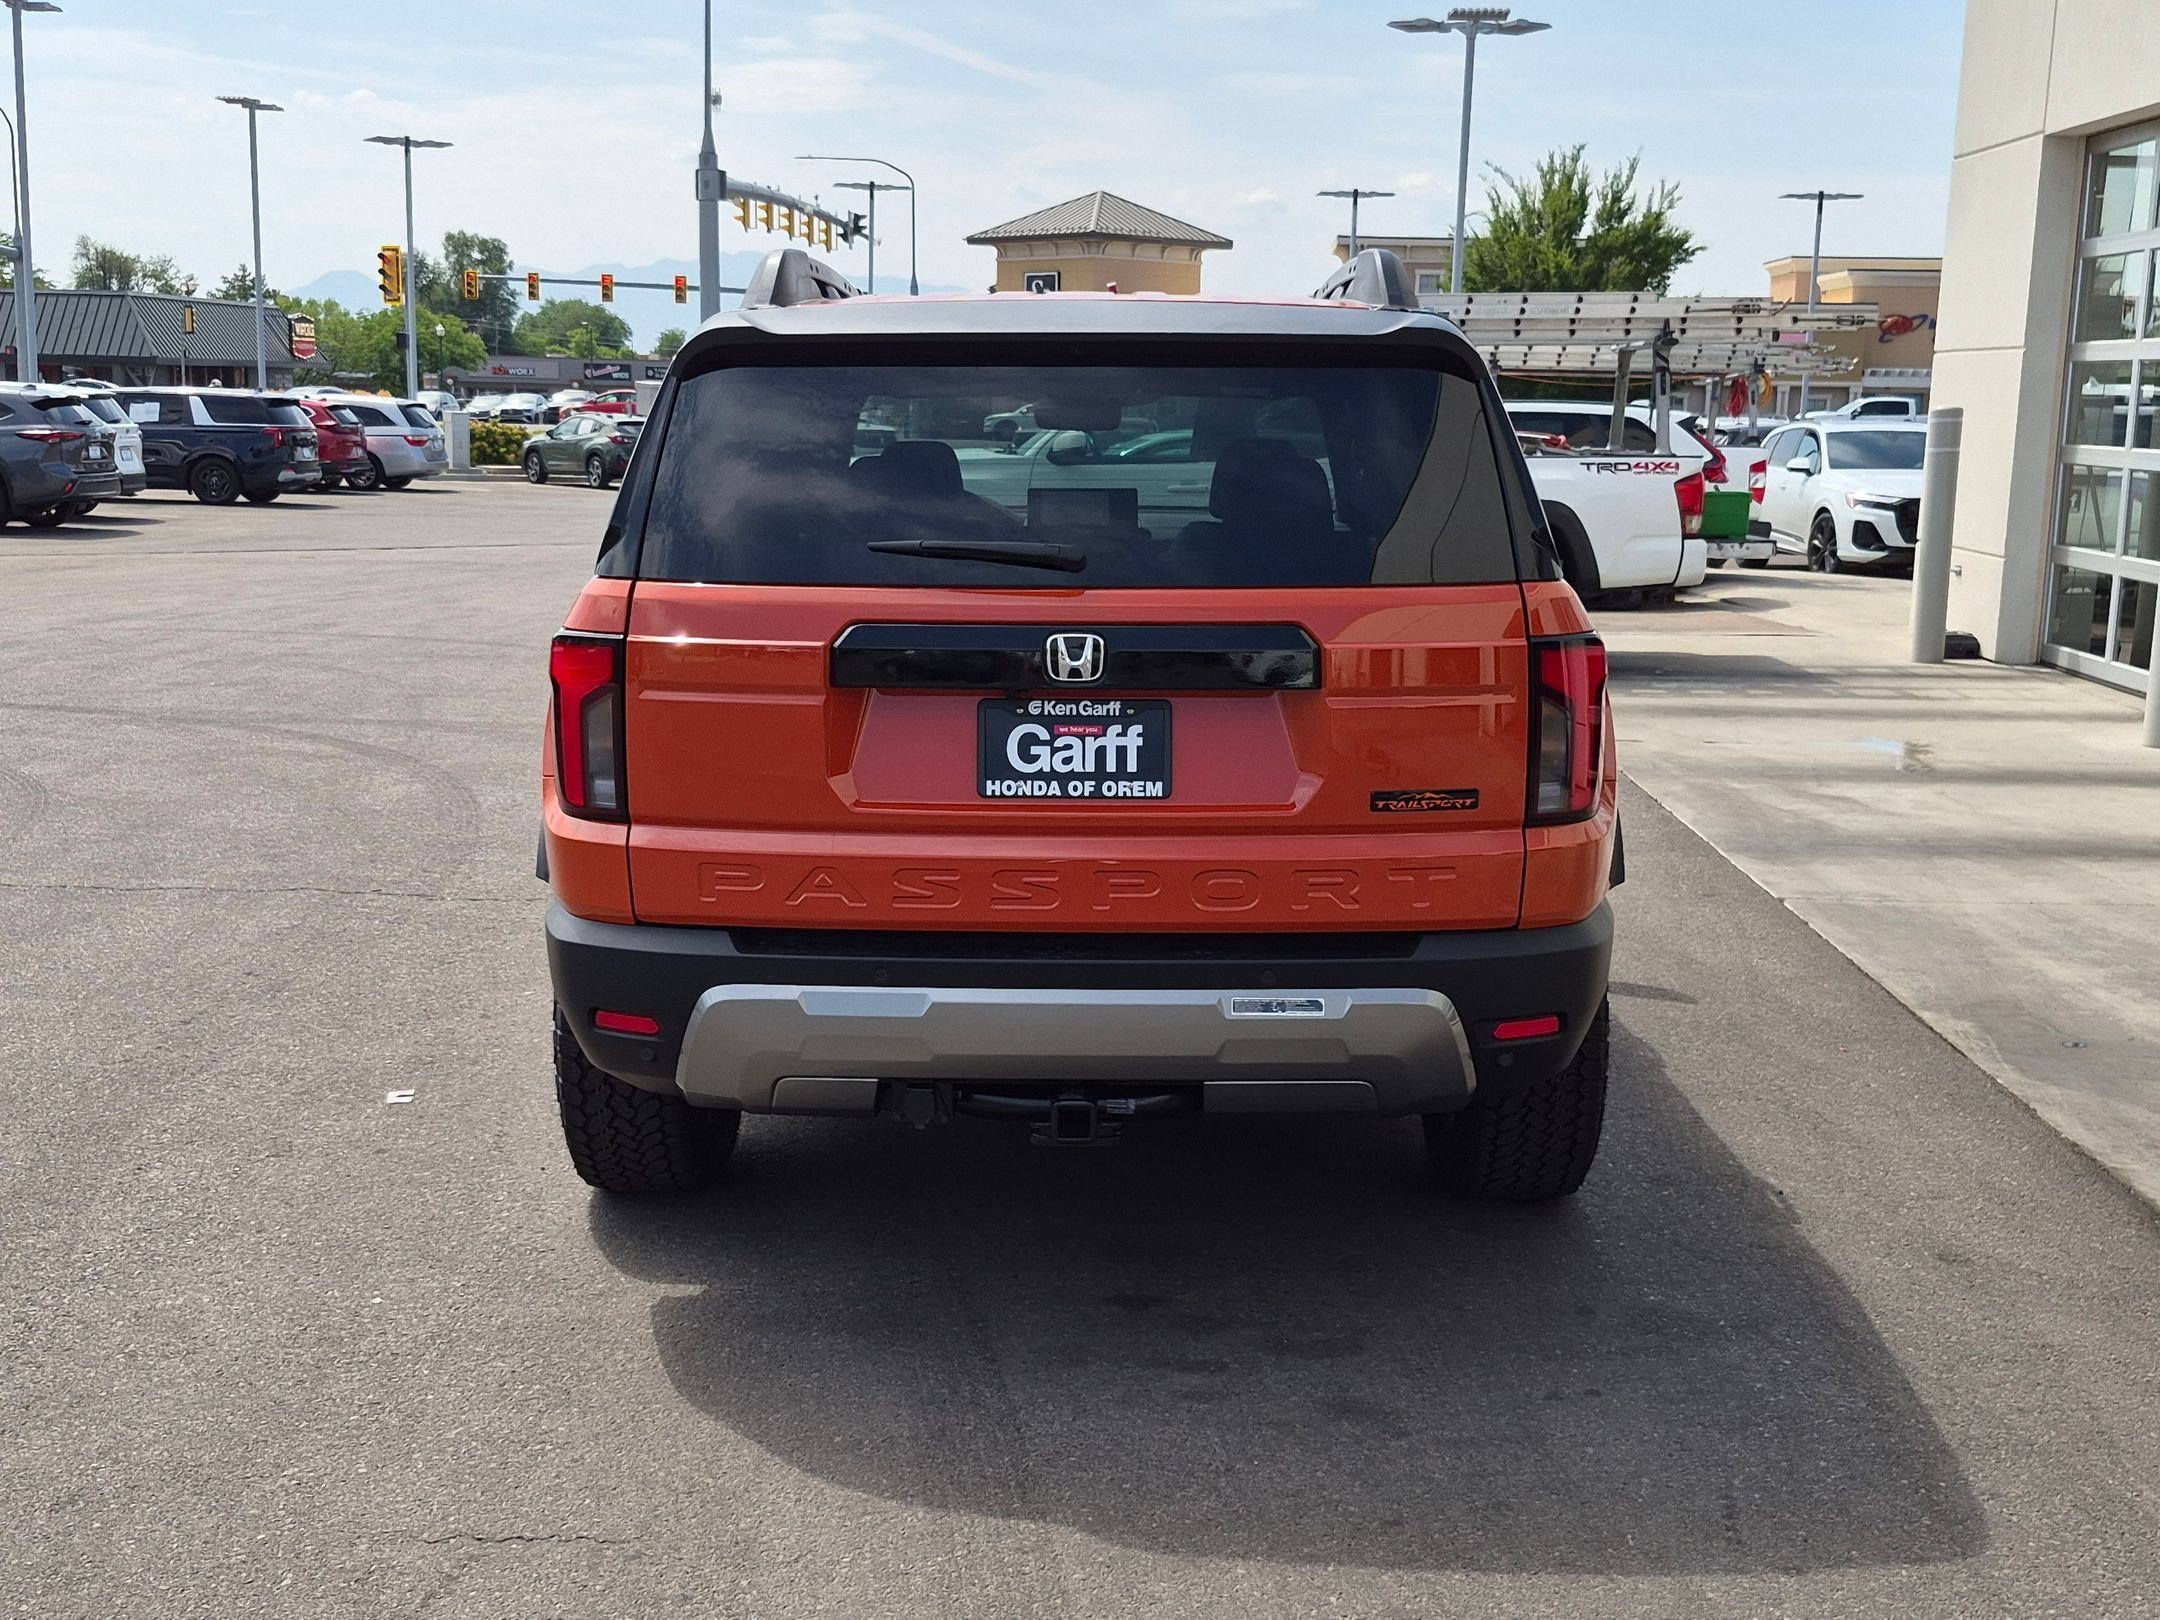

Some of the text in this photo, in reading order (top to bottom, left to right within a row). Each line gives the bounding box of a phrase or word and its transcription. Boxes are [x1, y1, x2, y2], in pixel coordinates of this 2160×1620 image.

[1580, 462, 1632, 474] TRD
[1043, 700, 1121, 716] Ken Garff
[1006, 723, 1144, 773] Garff
[986, 780, 1163, 797] HONDA OF OREM
[1375, 799, 1477, 811] TRAILSPORT
[698, 861, 1457, 912] PASSPORT
